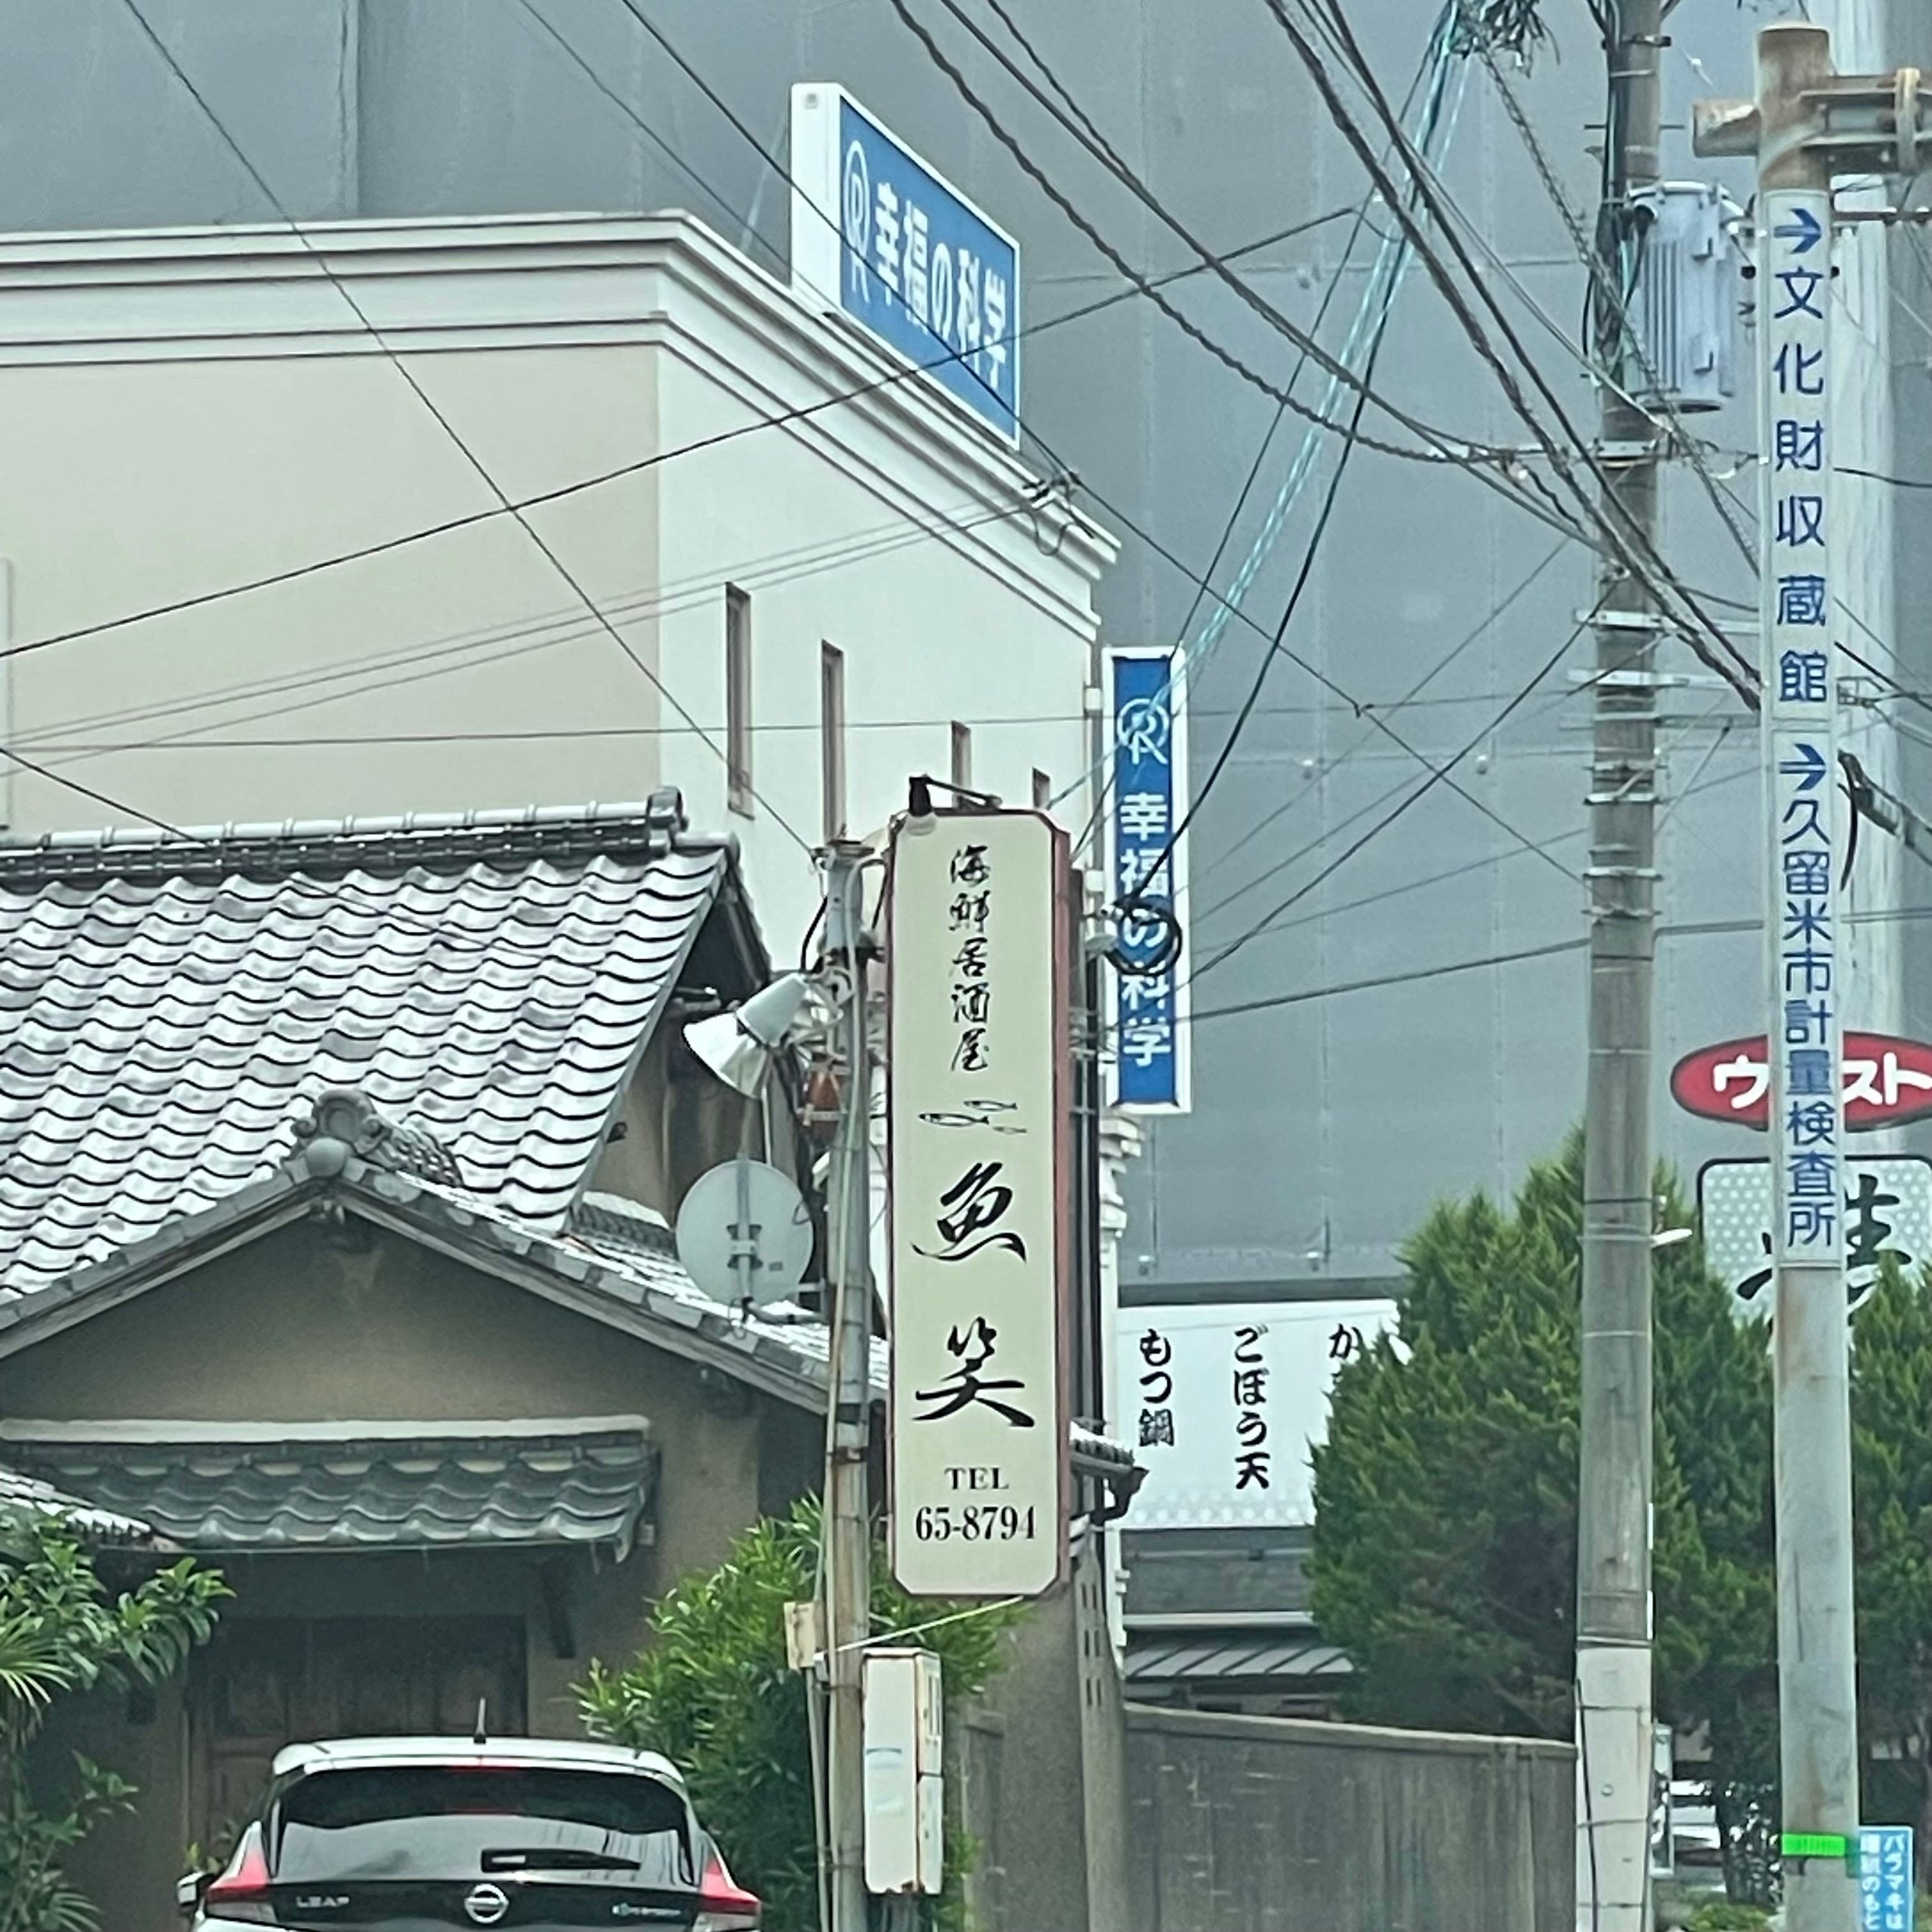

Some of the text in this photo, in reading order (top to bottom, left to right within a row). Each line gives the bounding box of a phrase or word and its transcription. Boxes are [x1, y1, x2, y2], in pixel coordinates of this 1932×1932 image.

[875, 181, 1006, 390] 幸福の科学
[1772, 265, 1828, 703] 文化財収蔵館
[948, 844, 992, 1071] 海鮮居酒屋
[1120, 792, 1172, 1066] 幸福の科学
[1712, 1052, 1932, 1109] ウスト
[1781, 799, 1837, 1248] 久留米市計量検査所
[944, 1467, 1010, 1490] TEL
[1139, 1328, 1175, 1447] もつ鍋
[1234, 1323, 1271, 1490] ごぼう天
[916, 1505, 1036, 1542] 65-8794
